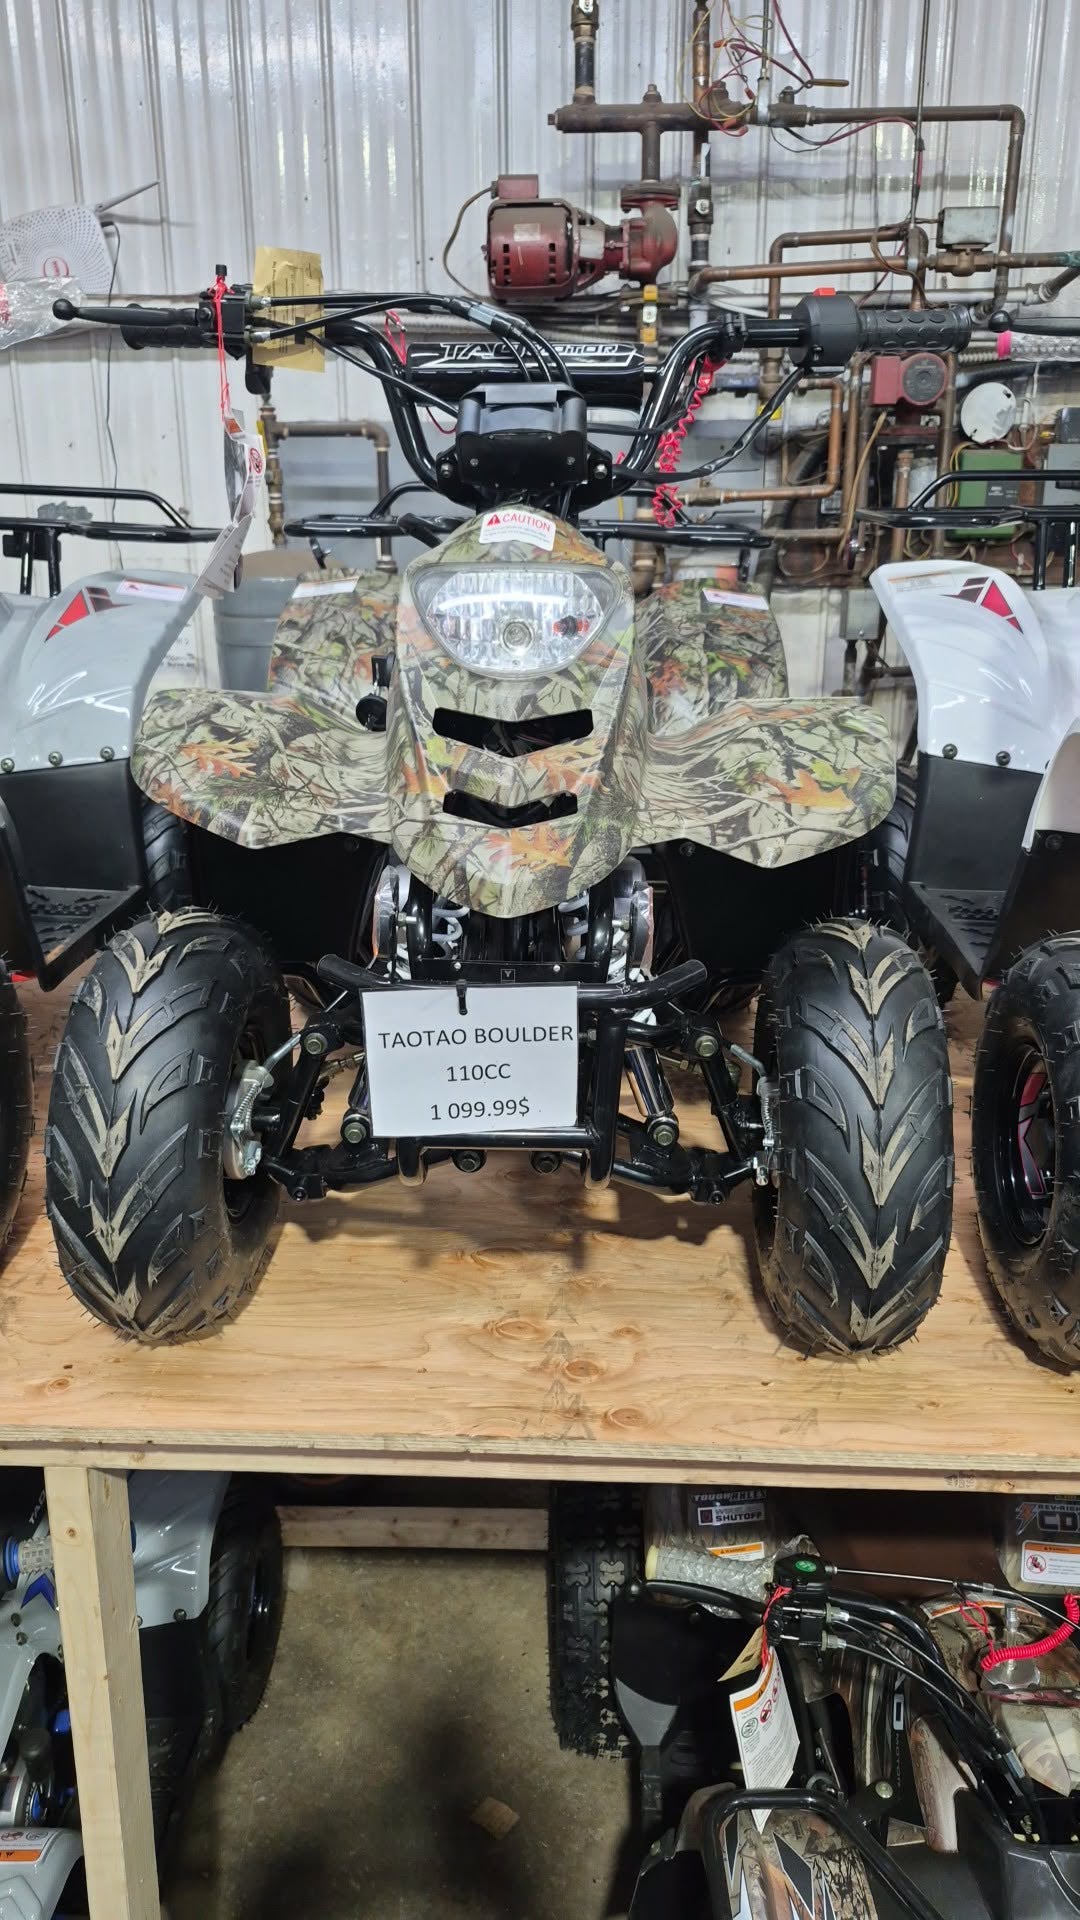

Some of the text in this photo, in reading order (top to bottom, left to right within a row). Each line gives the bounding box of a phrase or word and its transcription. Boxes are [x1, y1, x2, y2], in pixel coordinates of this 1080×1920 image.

[502, 513, 551, 532] CAUTION
[378, 1025, 573, 1049] TAOTAO BOULDER
[446, 1063, 512, 1082] 110CC
[715, 1511, 763, 1522] SHUTOFF
[1038, 1510, 1080, 1532] CD
